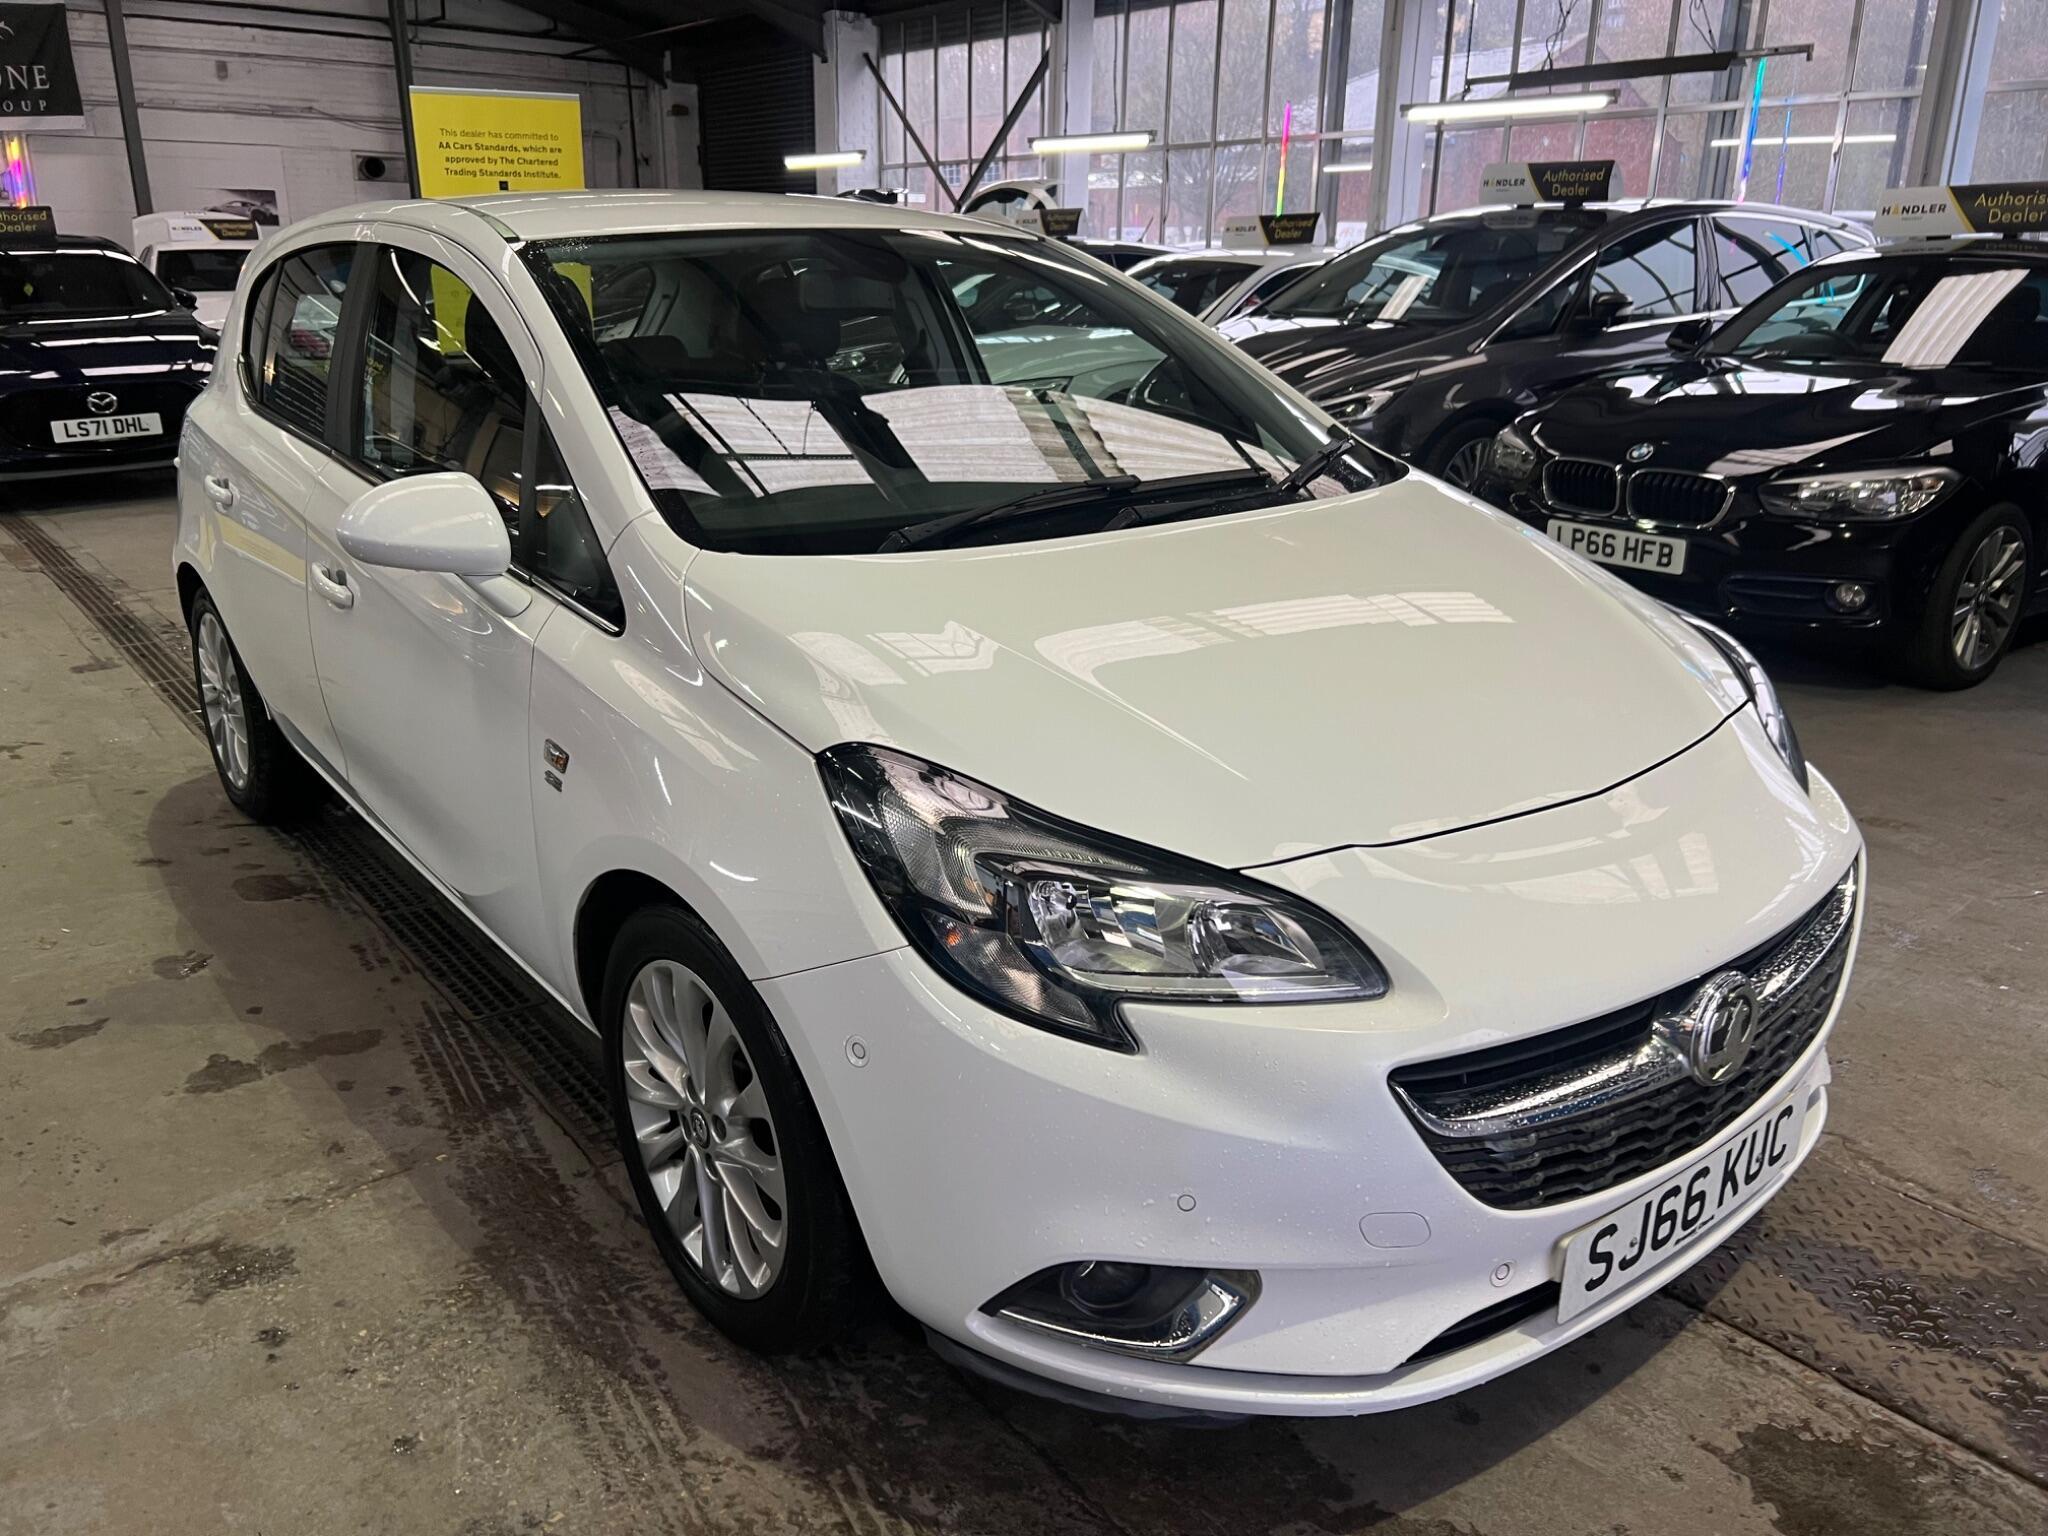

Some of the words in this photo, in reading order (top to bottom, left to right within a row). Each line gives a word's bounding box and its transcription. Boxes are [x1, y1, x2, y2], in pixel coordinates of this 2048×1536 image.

[0, 65, 50, 90] NE
[440, 128, 458, 137] This
[460, 129, 486, 138] dealer
[488, 131, 503, 139] has
[505, 132, 549, 141] committed
[550, 133, 559, 141] to
[439, 141, 451, 150] AA
[453, 142, 473, 151] Cars
[523, 144, 548, 153] which
[445, 155, 486, 165] approved
[487, 156, 498, 166] by
[500, 156, 515, 165] The
[517, 157, 559, 166] Chartered
[445, 168, 477, 178] Trading
[479, 169, 522, 178] Standards
[1543, 168, 1605, 183] Authorised
[1552, 184, 1590, 197] Dealer
[1974, 190, 2048, 208] Authoris
[1988, 207, 2045, 224] Dealer
[64, 419, 109, 438] LS71
[112, 416, 150, 434] DHL
[1623, 536, 1674, 567] HFB
[1584, 1165, 1711, 1292] SJ66
[1717, 1104, 1794, 1209] KUC
